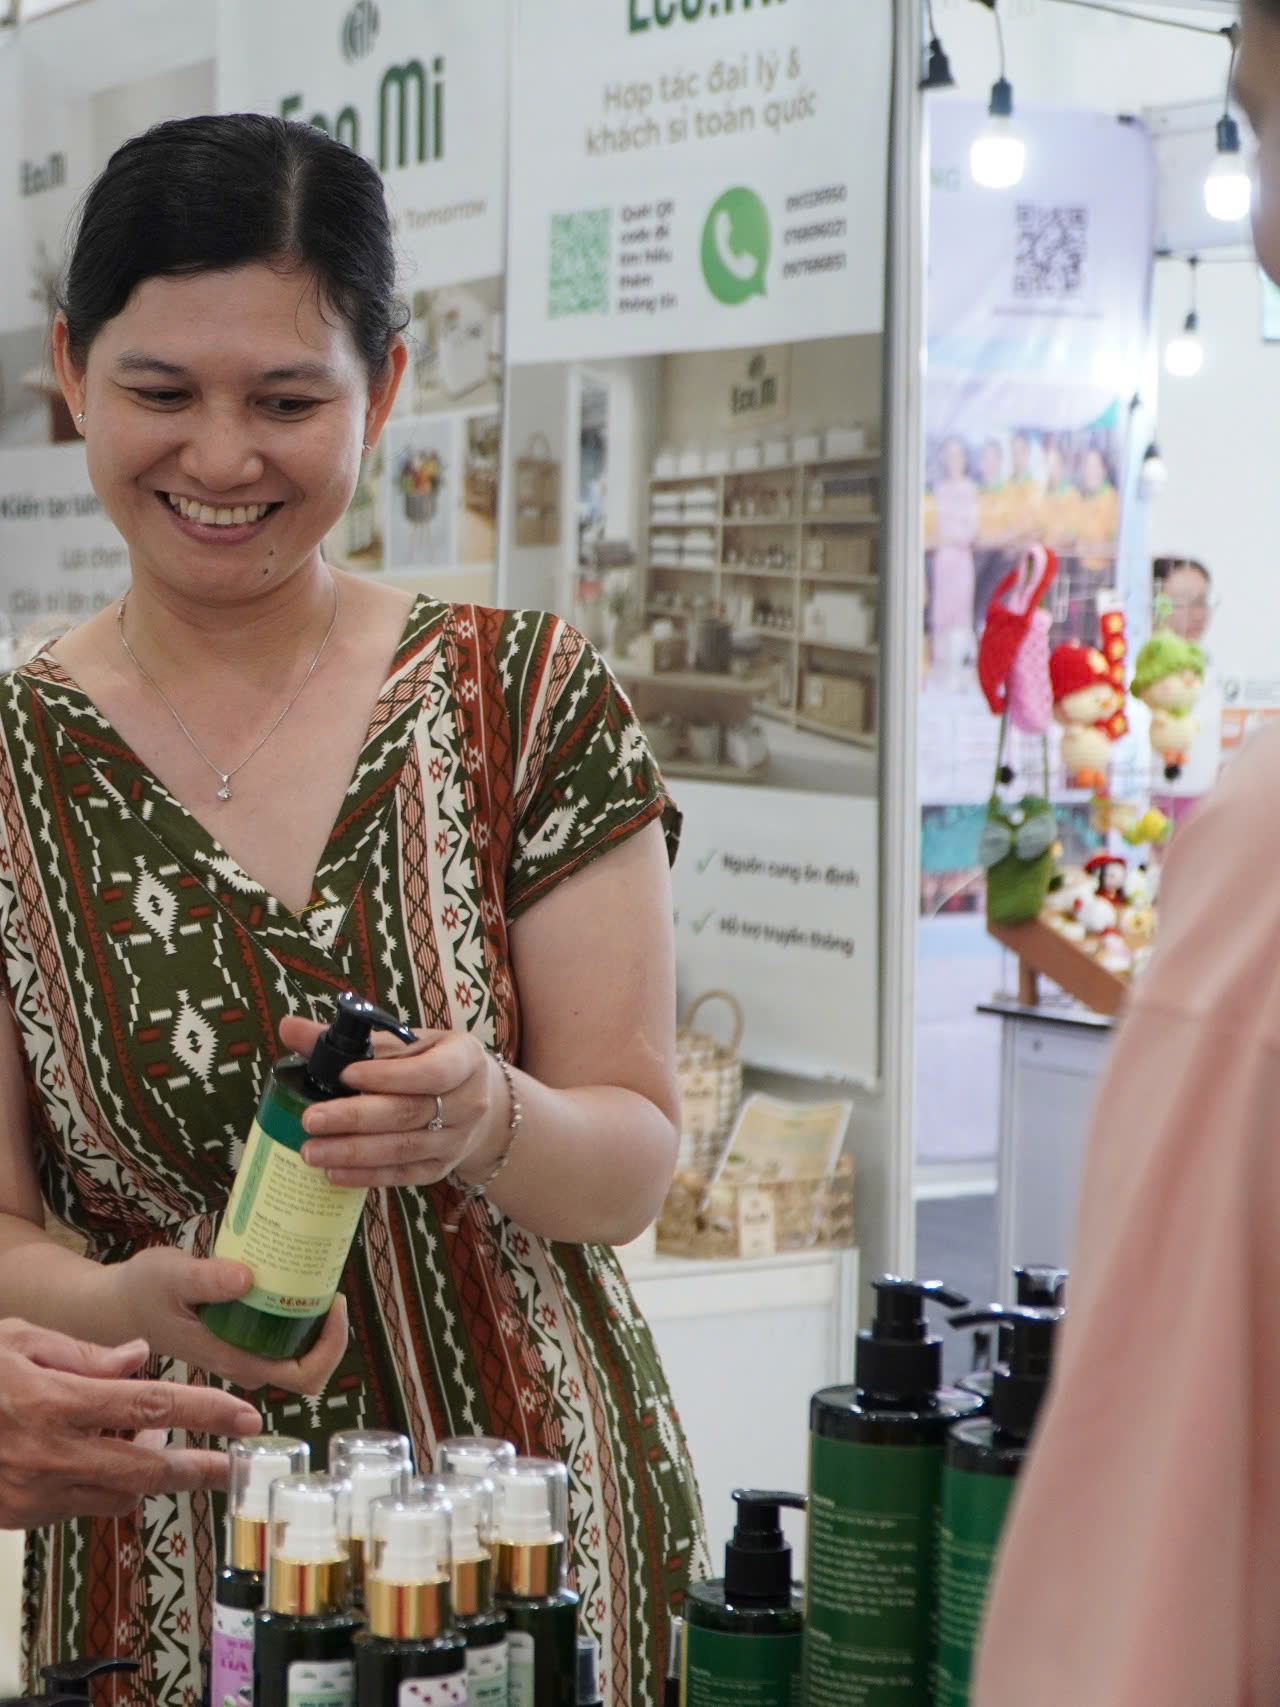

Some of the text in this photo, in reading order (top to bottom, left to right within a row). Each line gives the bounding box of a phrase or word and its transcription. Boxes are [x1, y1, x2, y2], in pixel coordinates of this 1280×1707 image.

[603, 82, 653, 114] Hợp
[659, 70, 699, 104] tác
[707, 53, 748, 97] đại
[586, 114, 660, 156] khách
[694, 100, 755, 139] toàn
[763, 83, 817, 132] quốc
